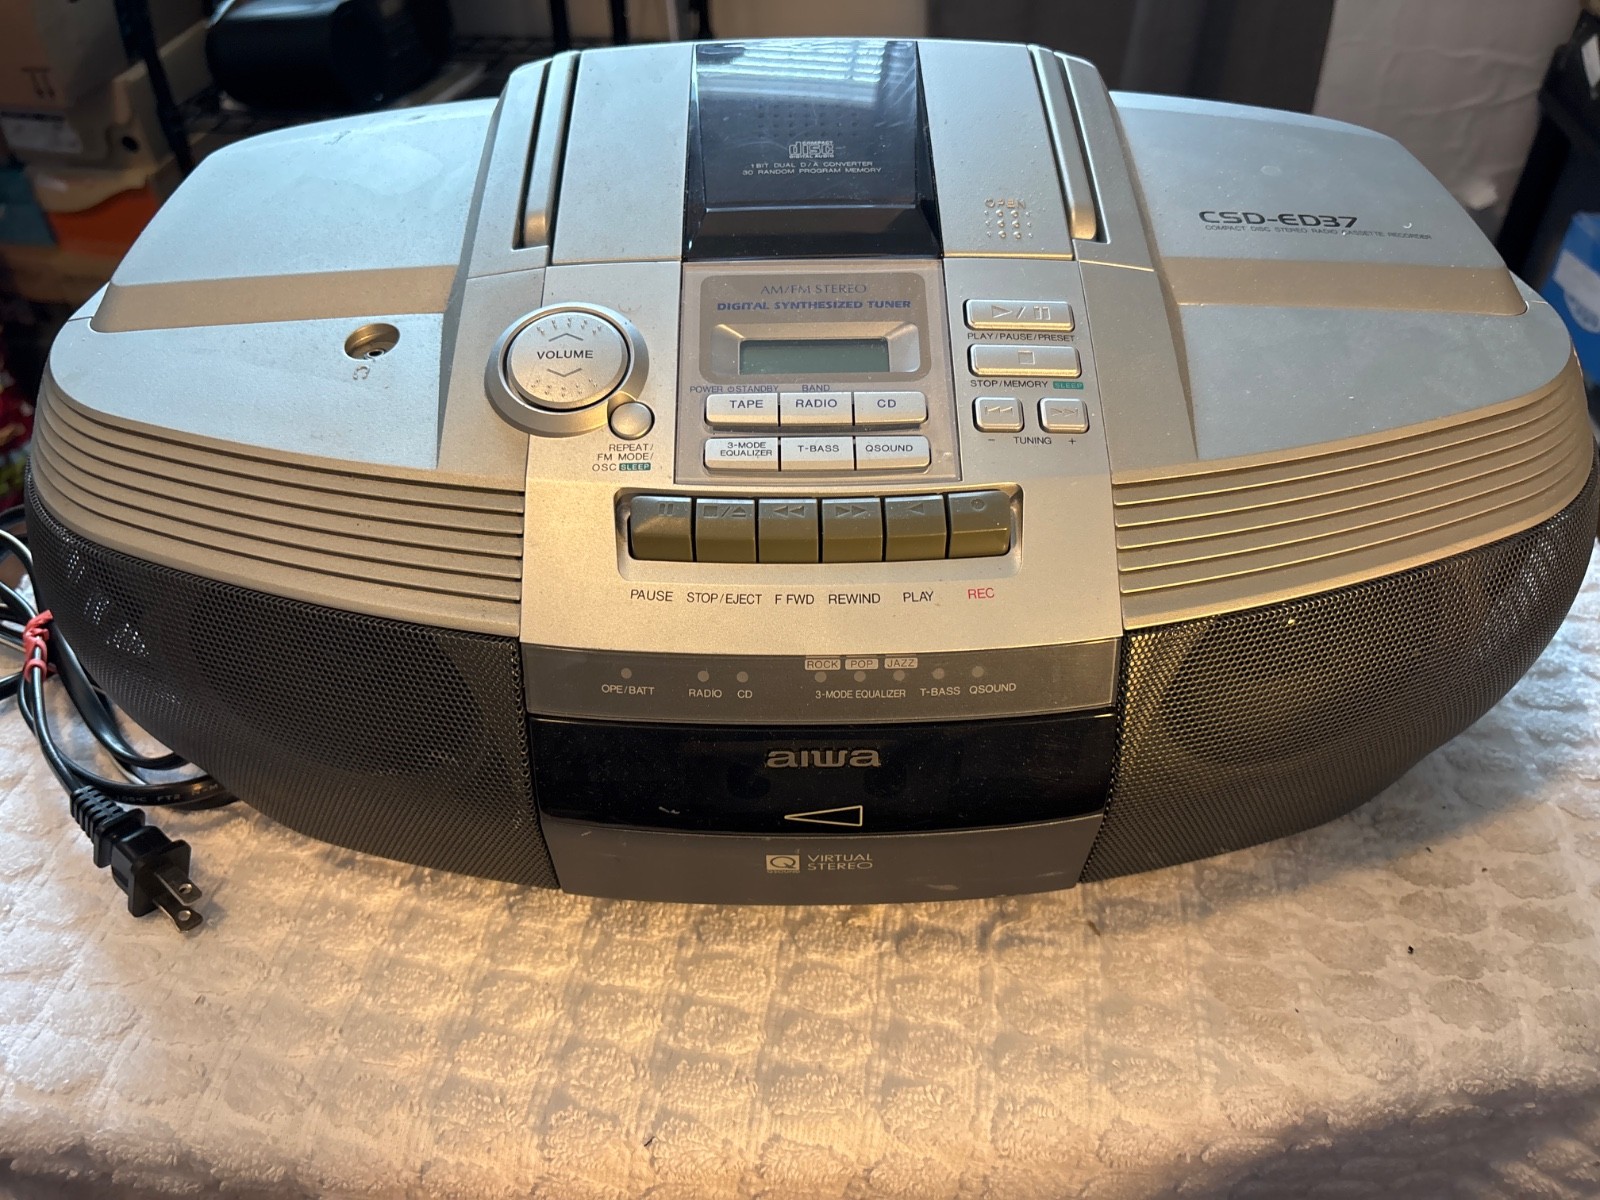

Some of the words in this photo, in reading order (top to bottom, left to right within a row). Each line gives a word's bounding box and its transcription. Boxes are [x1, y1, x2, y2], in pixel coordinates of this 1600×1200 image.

[1198, 210, 1358, 228] CSD-ED37
[1274, 226, 1308, 234] STEREO
[760, 283, 811, 295] AM/FM
[815, 284, 867, 294] STEREO
[717, 302, 770, 311] DIGITAL
[774, 301, 863, 310] SYNTHESIZED
[868, 300, 911, 309] TUNER
[967, 333, 1075, 342] PLAY/PAUSE/PRESET
[537, 350, 594, 360] VOLUME
[801, 384, 831, 392] BAND
[970, 380, 1048, 388] STOP/MEMORY
[729, 399, 764, 409] TAPE
[795, 398, 838, 408] RADIO
[876, 399, 897, 409] CD
[727, 441, 767, 449] 3-MODE
[1013, 436, 1052, 445] TUNING
[609, 443, 654, 452] REPEAT/
[798, 445, 840, 453] T-BASS
[865, 444, 913, 453] QSOUND
[597, 453, 613, 461] FM
[618, 453, 654, 461] MODE/
[720, 449, 773, 457] EQUALIZER
[592, 463, 617, 471] OSC
[630, 589, 674, 602] PAUSE
[686, 592, 762, 604] STOP/EJECT
[902, 591, 934, 603] PLAY
[967, 587, 995, 599] REC
[774, 594, 782, 604] F
[786, 594, 815, 604] FWD
[828, 593, 881, 605] REWIND
[806, 660, 838, 669] ROCK
[850, 659, 874, 668] POP
[886, 658, 915, 668] JAZZ
[601, 684, 655, 695] OPE/BATT
[688, 688, 723, 698] RADIO
[920, 687, 961, 697] T-BASS
[969, 682, 1017, 695] QSOUND
[737, 690, 753, 699] CD
[815, 690, 853, 699] 3-MODE
[855, 689, 906, 698] EQUALIZER
[767, 749, 881, 768] aiwa
[807, 853, 873, 862] VIRTUAL
[807, 861, 873, 871] STEREO
